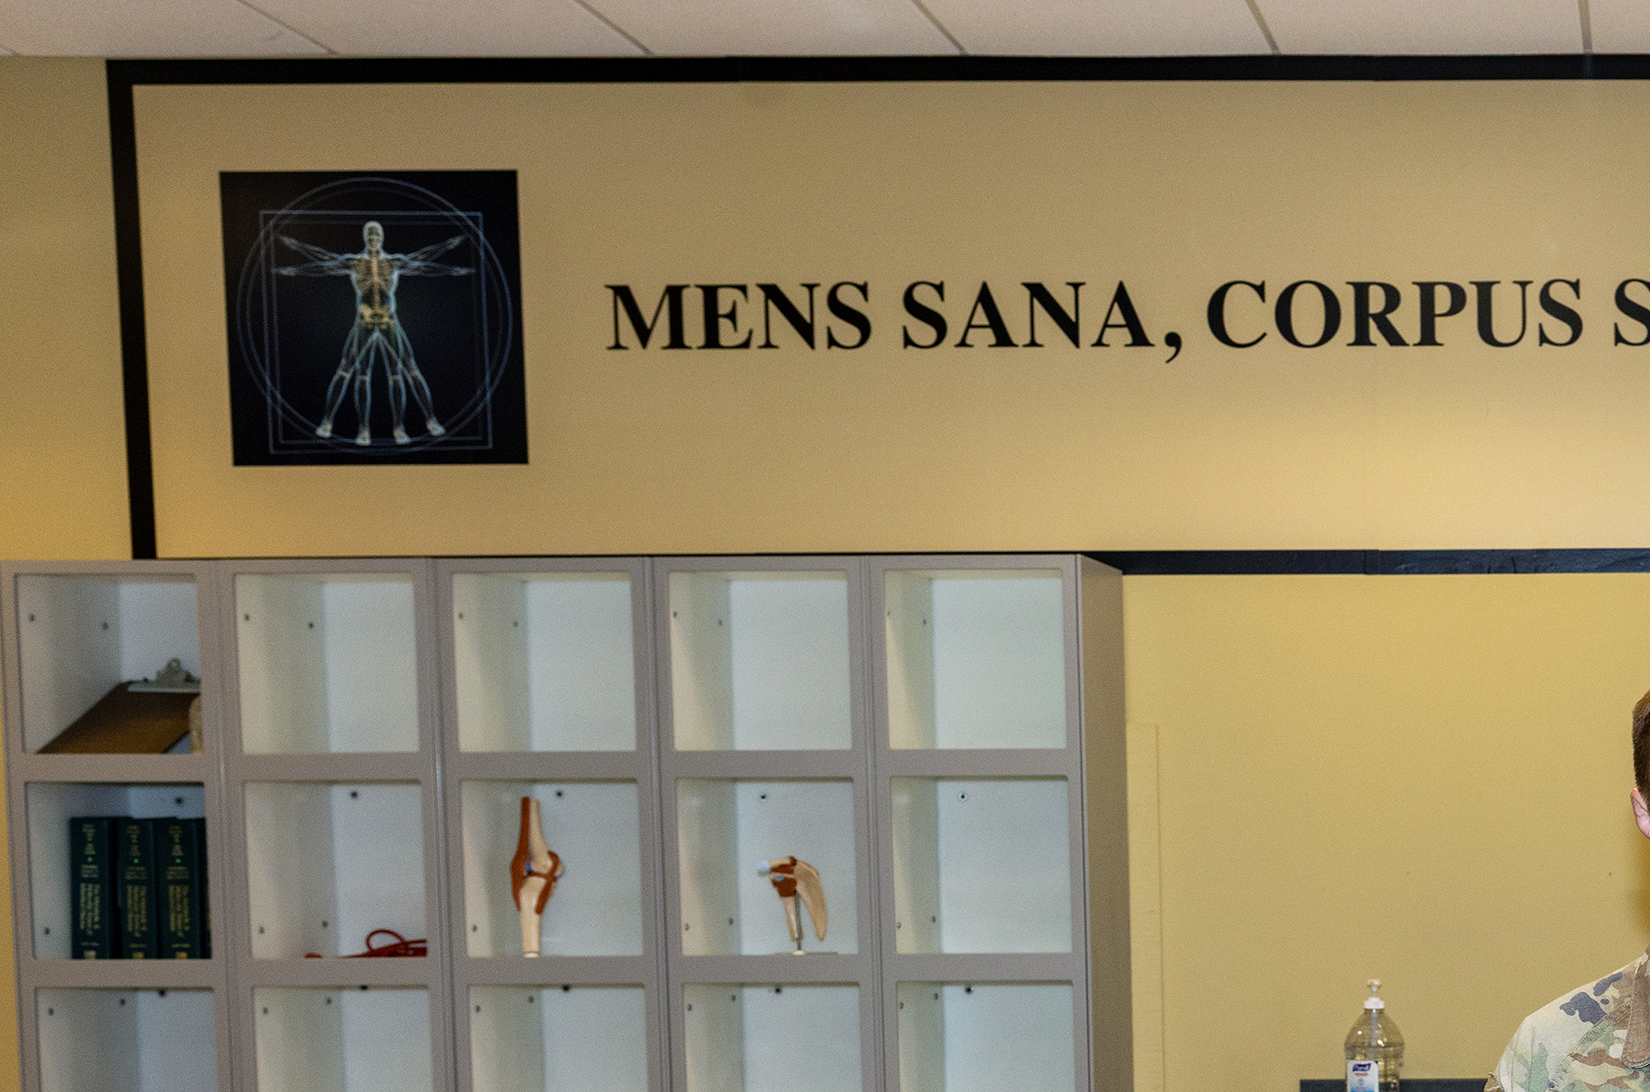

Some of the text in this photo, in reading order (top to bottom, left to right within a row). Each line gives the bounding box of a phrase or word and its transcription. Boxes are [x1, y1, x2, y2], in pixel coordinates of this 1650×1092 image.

[604, 279, 873, 351] MENS
[901, 279, 1184, 364] SANA,
[1205, 277, 1584, 349] CORPUS
